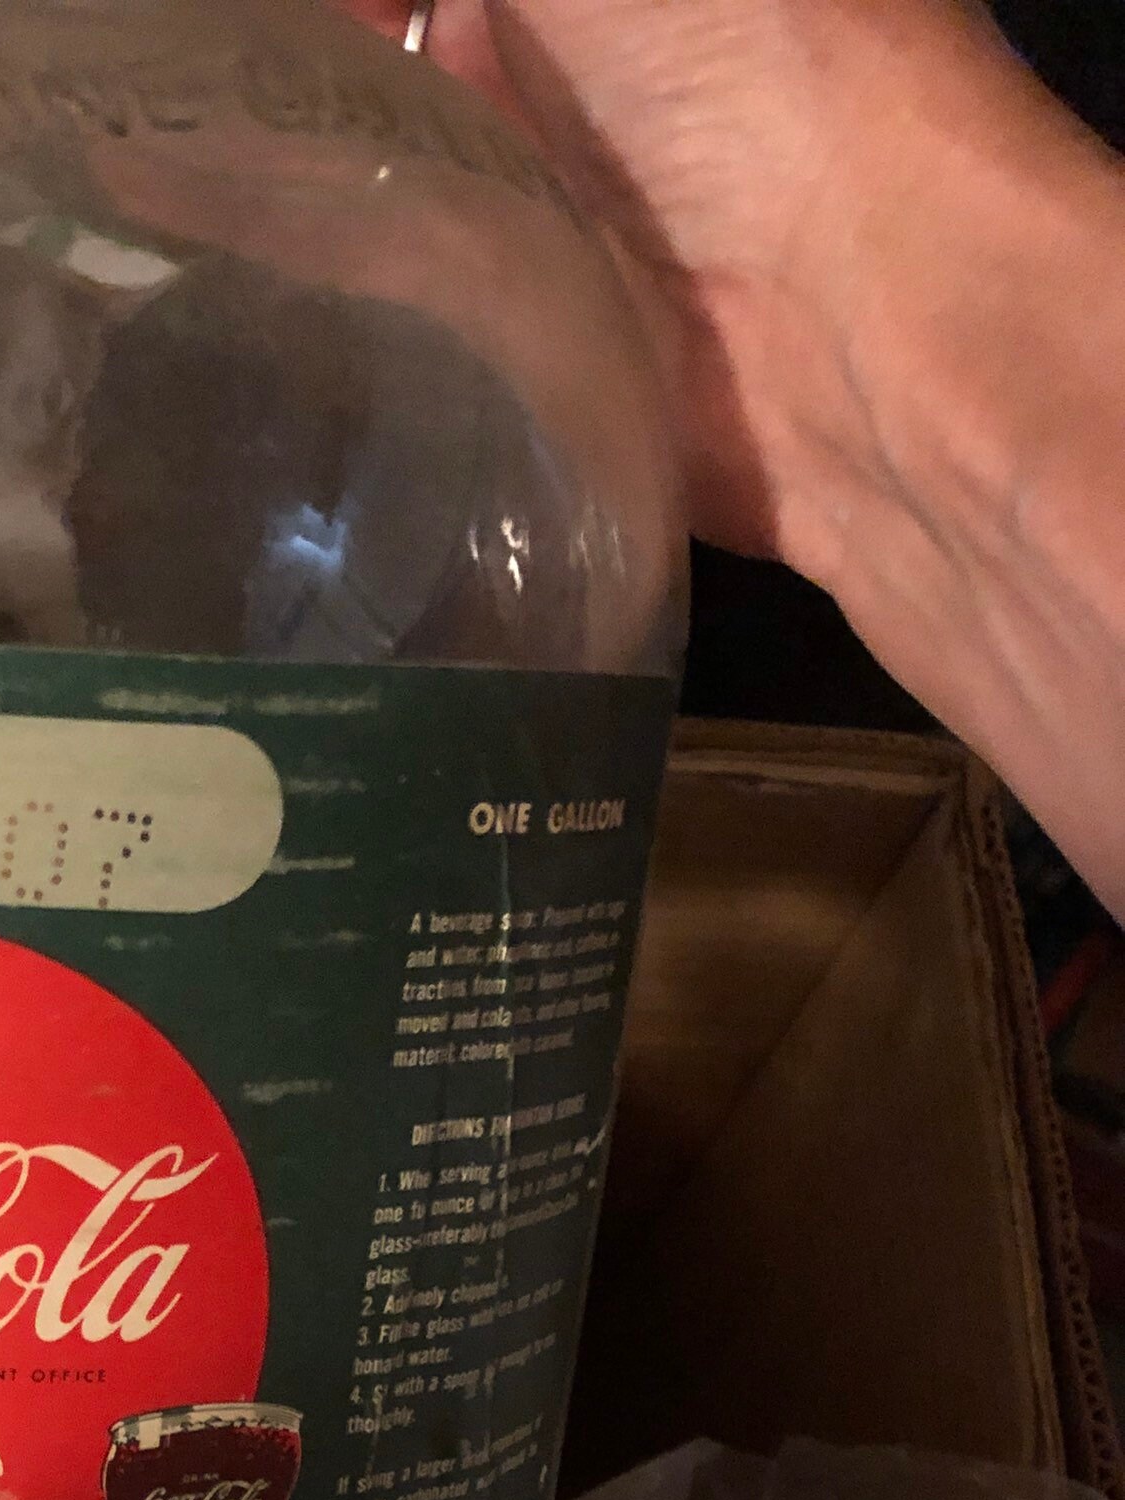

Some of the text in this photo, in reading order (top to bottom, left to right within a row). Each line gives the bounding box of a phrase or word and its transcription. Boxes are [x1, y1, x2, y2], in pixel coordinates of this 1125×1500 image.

[468, 801, 625, 836] ONE GALLON
[373, 1205, 404, 1226] one
[30, 1369, 108, 1384] OFFICE
[394, 1375, 425, 1398] with
